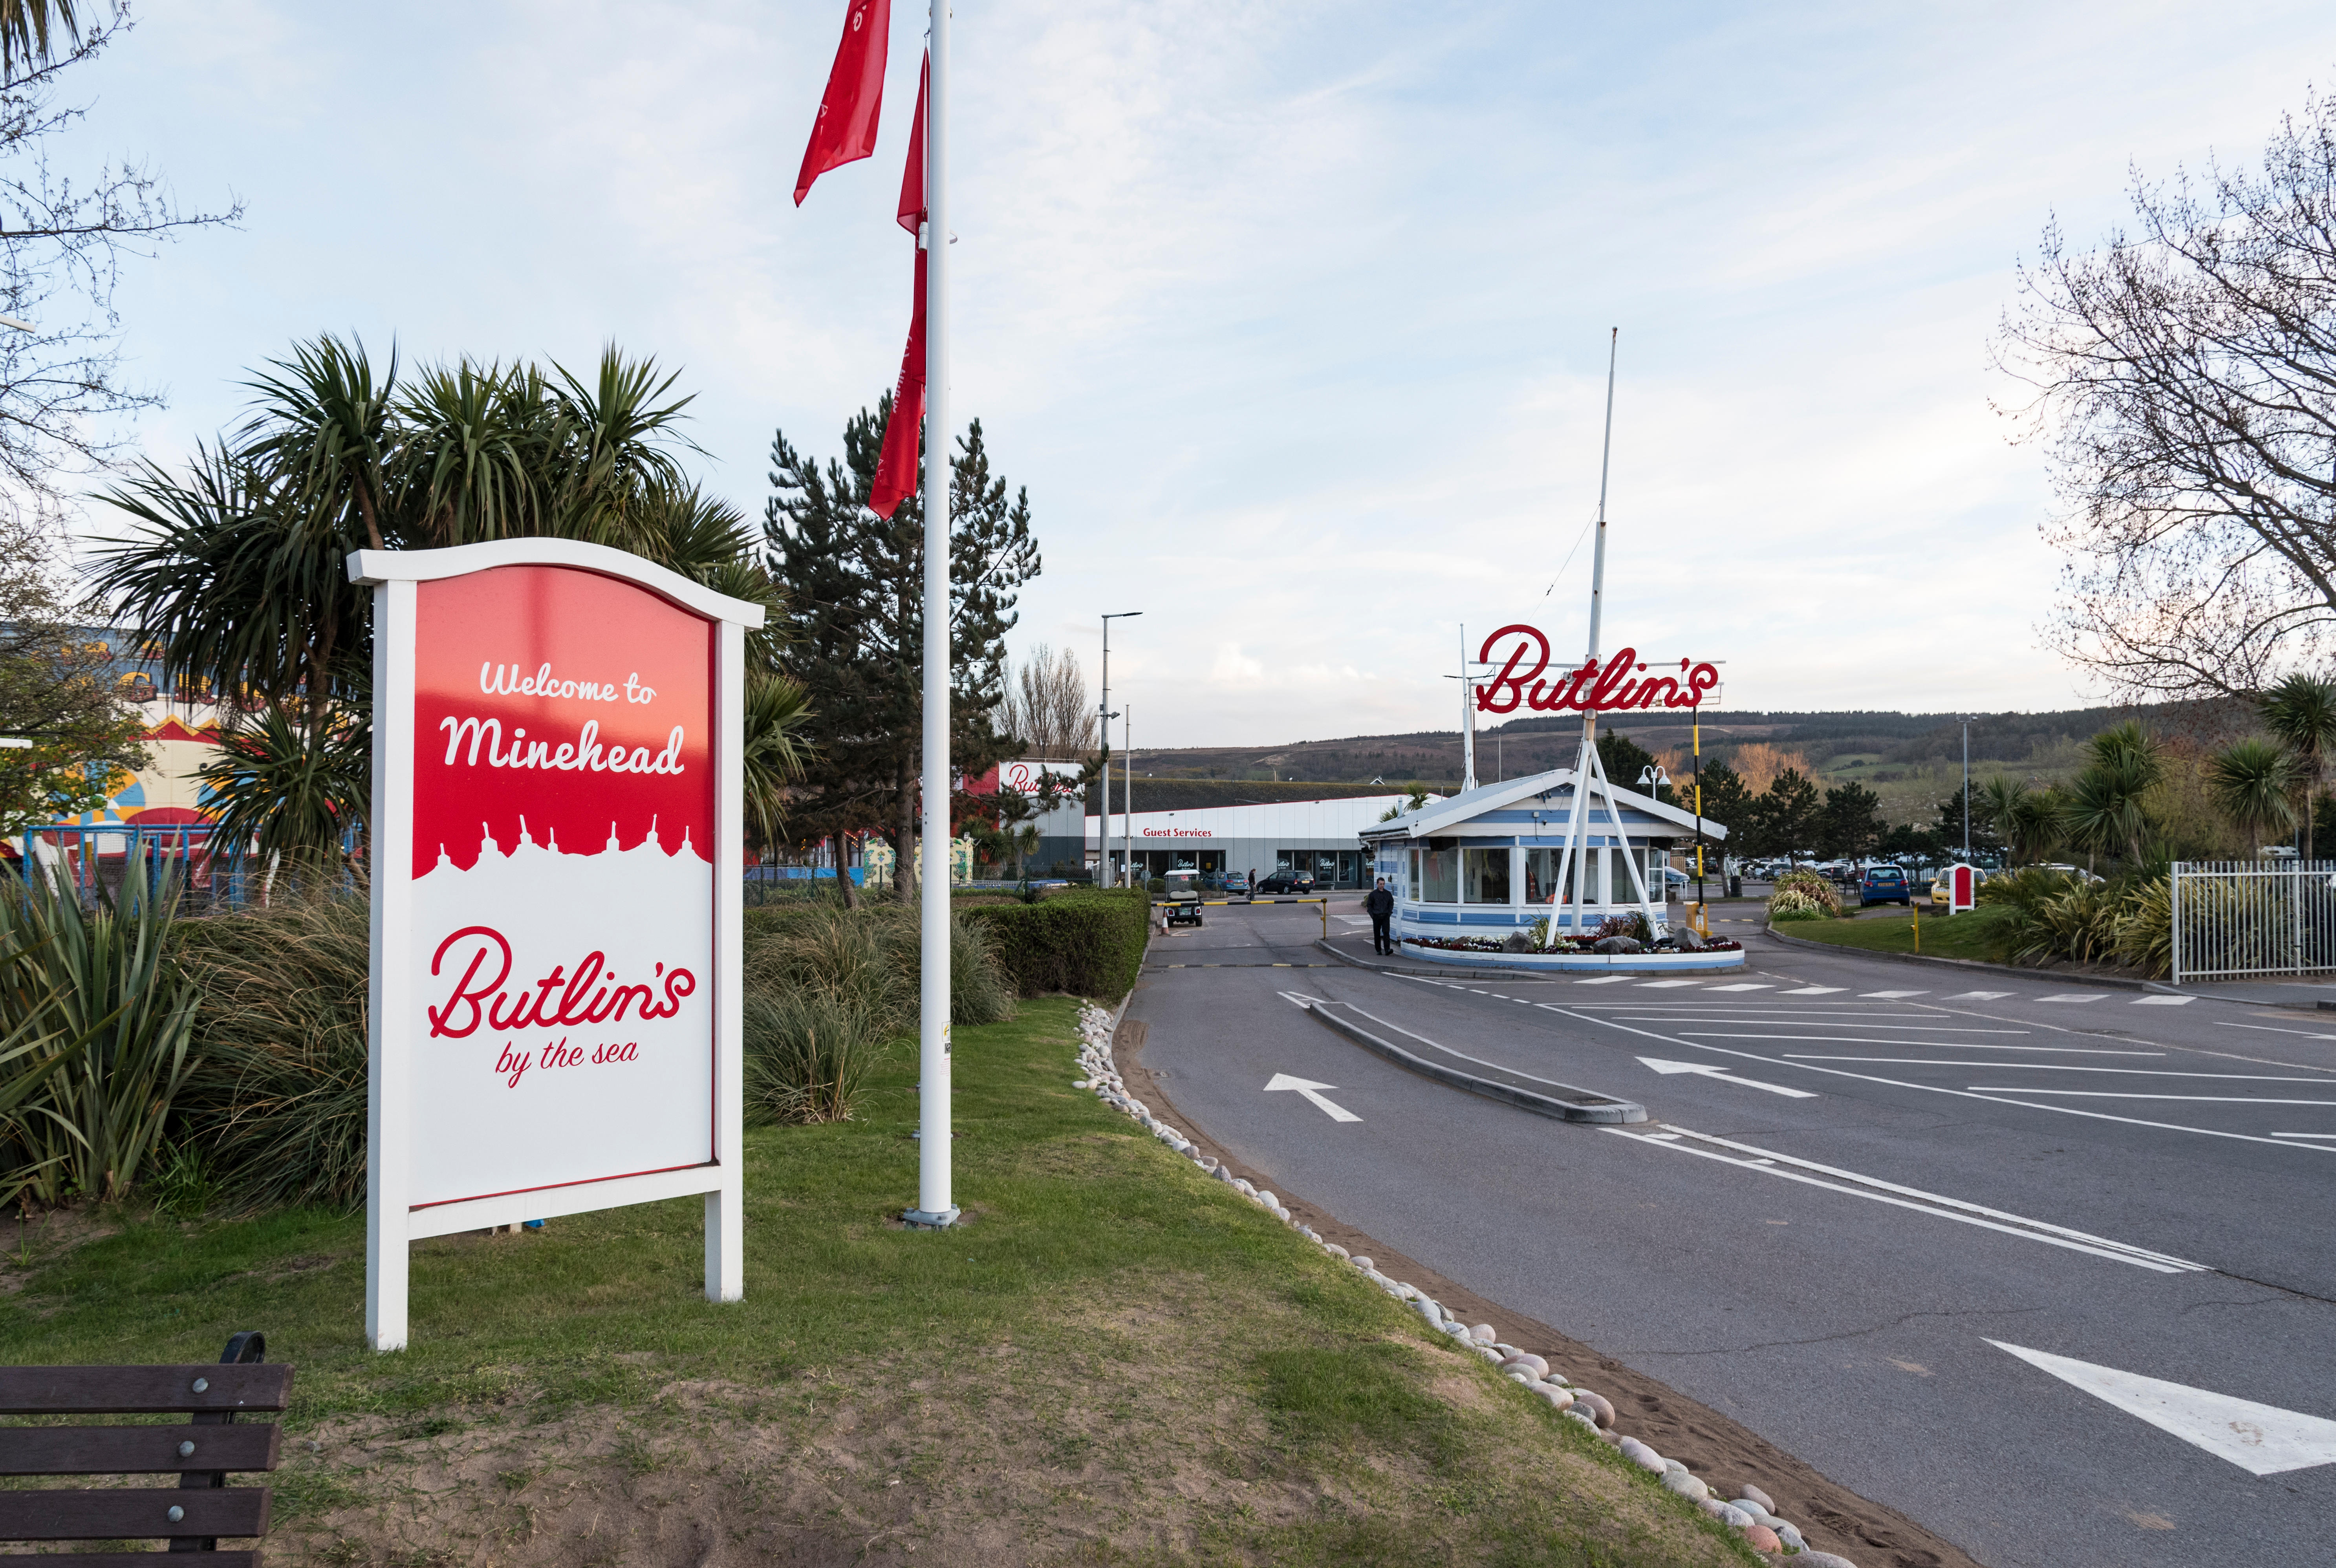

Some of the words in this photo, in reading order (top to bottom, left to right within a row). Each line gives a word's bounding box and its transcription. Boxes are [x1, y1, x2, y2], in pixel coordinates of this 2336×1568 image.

[480, 662, 619, 702] Welcome
[623, 672, 657, 704] to
[1476, 624, 1718, 714] Butlin's
[439, 716, 684, 775] Minehead
[1143, 828, 1170, 837] Guest
[1173, 828, 1212, 837] Services
[1178, 859, 1194, 867] Butlin's
[428, 926, 696, 1039] Butlin's
[495, 1041, 532, 1089] by
[540, 1036, 585, 1069] the
[591, 1042, 639, 1065] sea
